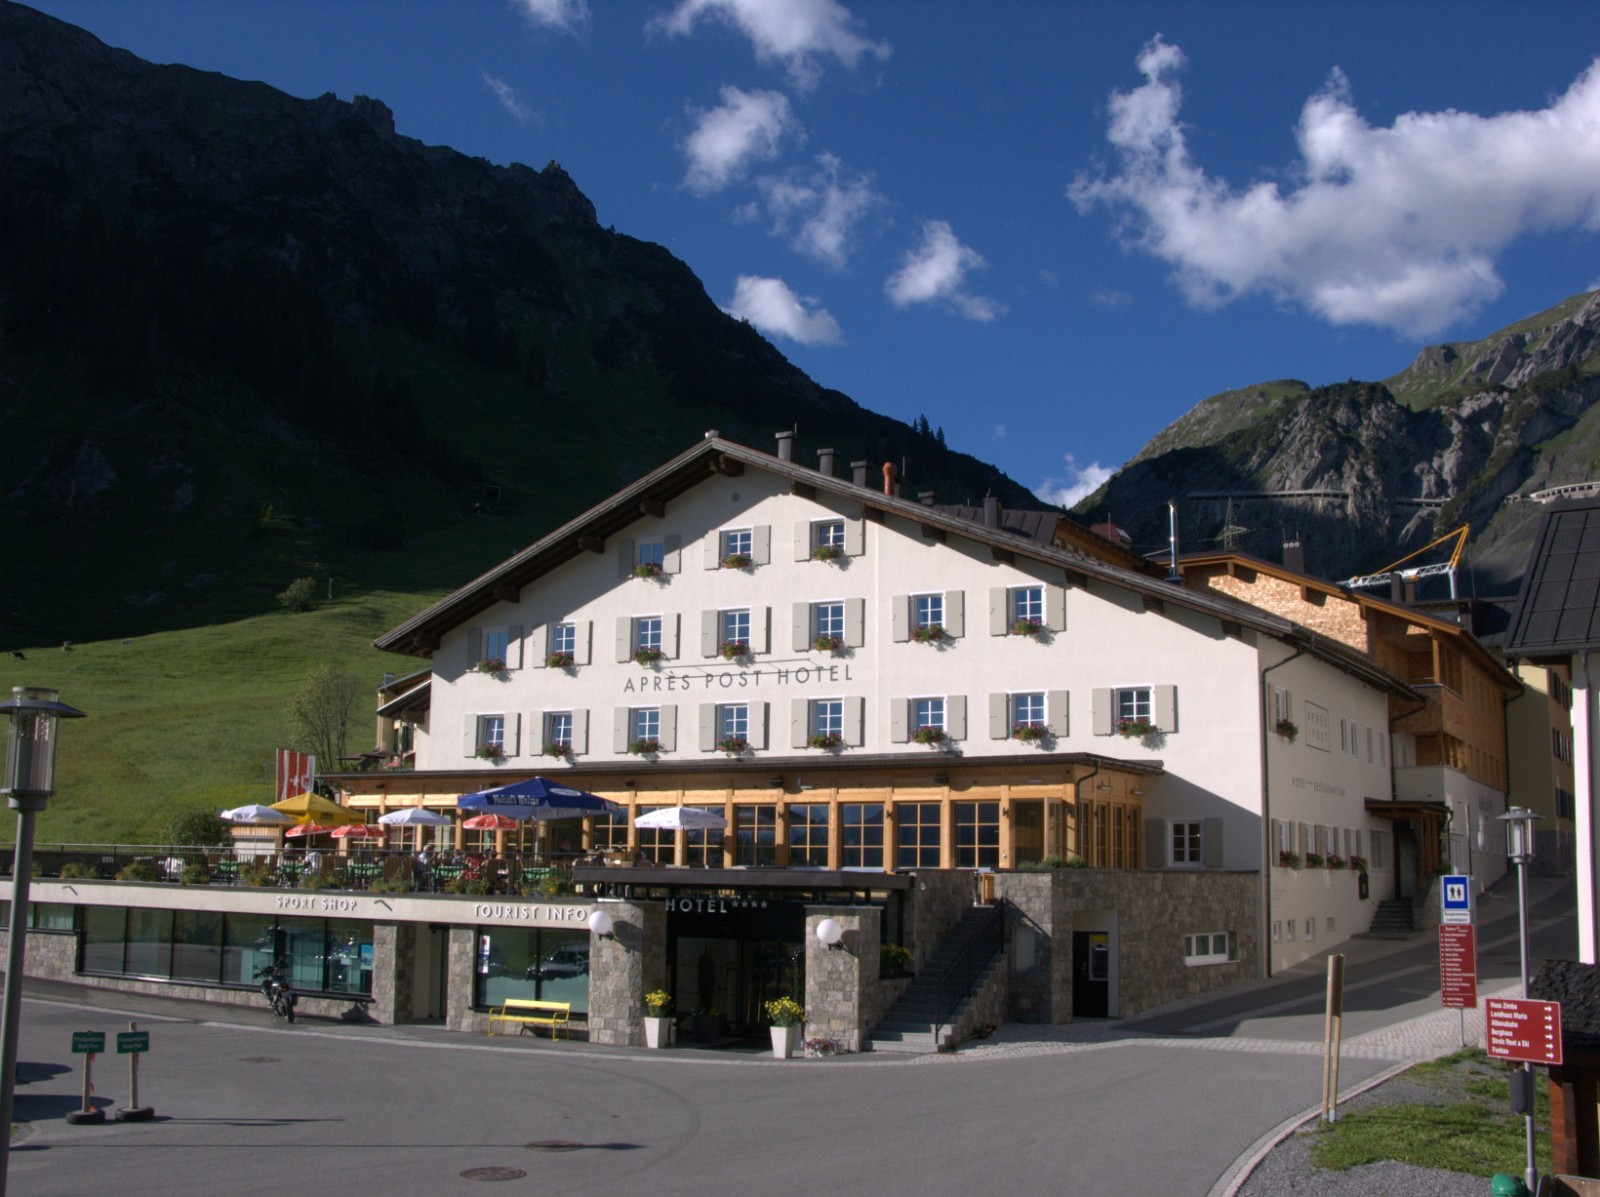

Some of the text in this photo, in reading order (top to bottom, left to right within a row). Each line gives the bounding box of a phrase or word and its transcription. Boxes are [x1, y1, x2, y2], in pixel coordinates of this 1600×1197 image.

[623, 664, 853, 693] APRÈS POST HOTEL
[275, 896, 357, 912] SPORT SHOP
[665, 898, 728, 913] HOTEL
[473, 904, 588, 922] TOURIST INFO
[1490, 1010, 1528, 1020] Landhaus Maria
[1505, 1038, 1517, 1046] Rent
[1521, 1039, 1530, 1048] Ski
